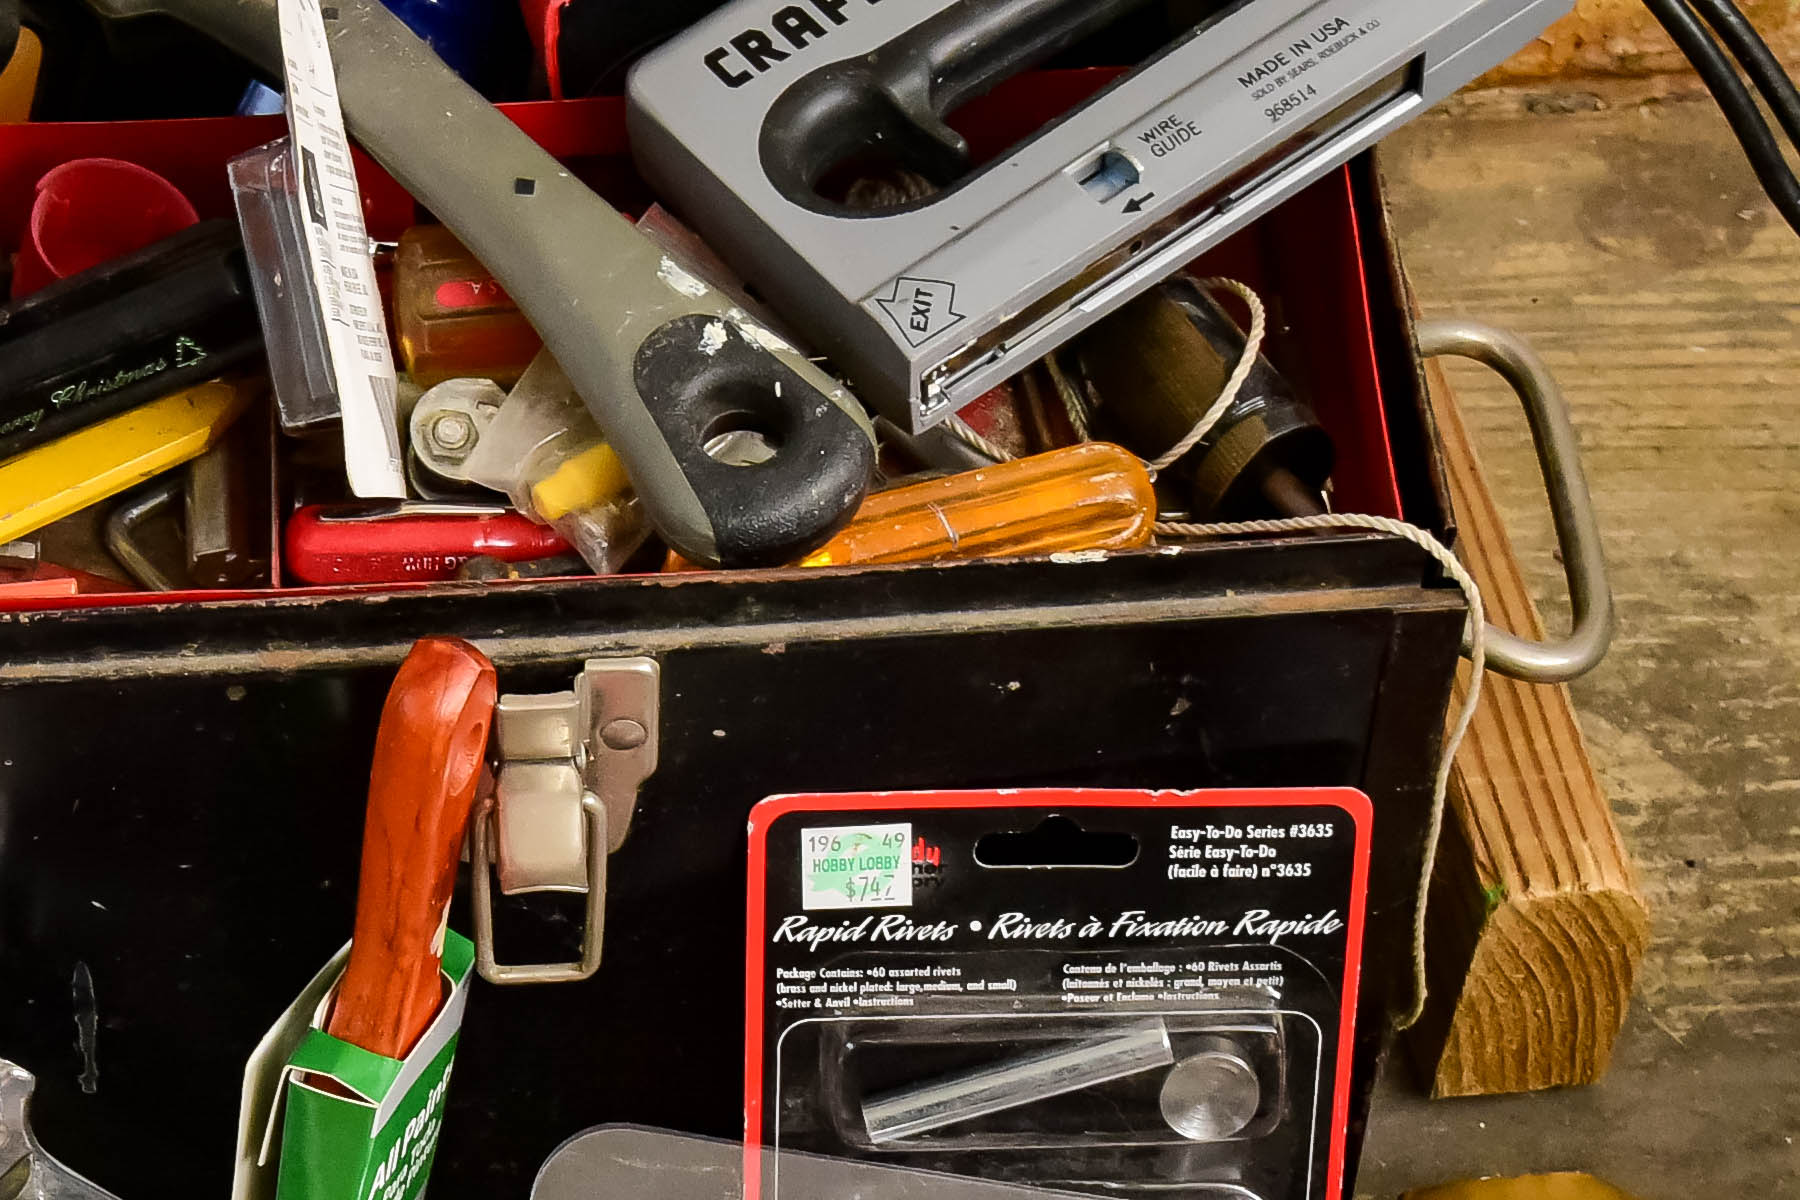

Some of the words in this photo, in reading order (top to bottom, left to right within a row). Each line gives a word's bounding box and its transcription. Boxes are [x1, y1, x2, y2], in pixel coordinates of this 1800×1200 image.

[703, 0, 881, 89] CRAF
[1237, 52, 1291, 89] MADE
[1289, 39, 1312, 58] IN
[1310, 16, 1350, 48] USA
[1251, 83, 1274, 101] SOLD
[1264, 84, 1317, 123] 968514
[1137, 114, 1184, 144] WIRE
[1150, 121, 1203, 158] GUIDE
[910, 287, 934, 332] EXIT
[51, 358, 167, 408] Christmas
[809, 836, 841, 852] 196
[882, 833, 905, 848] 49
[1171, 825, 1242, 842] Easy-To-Do
[1246, 825, 1285, 839] Series
[1289, 824, 1333, 839] #3635
[812, 858, 855, 873] HOBBY
[859, 856, 900, 871] LOBBY
[1169, 845, 1201, 859] Série
[1205, 844, 1277, 861] Easy-To-Do
[1167, 864, 1207, 880] (facile
[1222, 863, 1258, 880] faire)
[773, 914, 875, 952] Rapid
[871, 914, 957, 942] Rivets
[988, 912, 1071, 942] Rivets
[1078, 915, 1102, 939] à
[1108, 911, 1227, 938] Fixation
[1232, 909, 1344, 944] Rapide
[776, 967, 817, 980] Package
[889, 966, 931, 977] assorted
[933, 966, 961, 977] rivets
